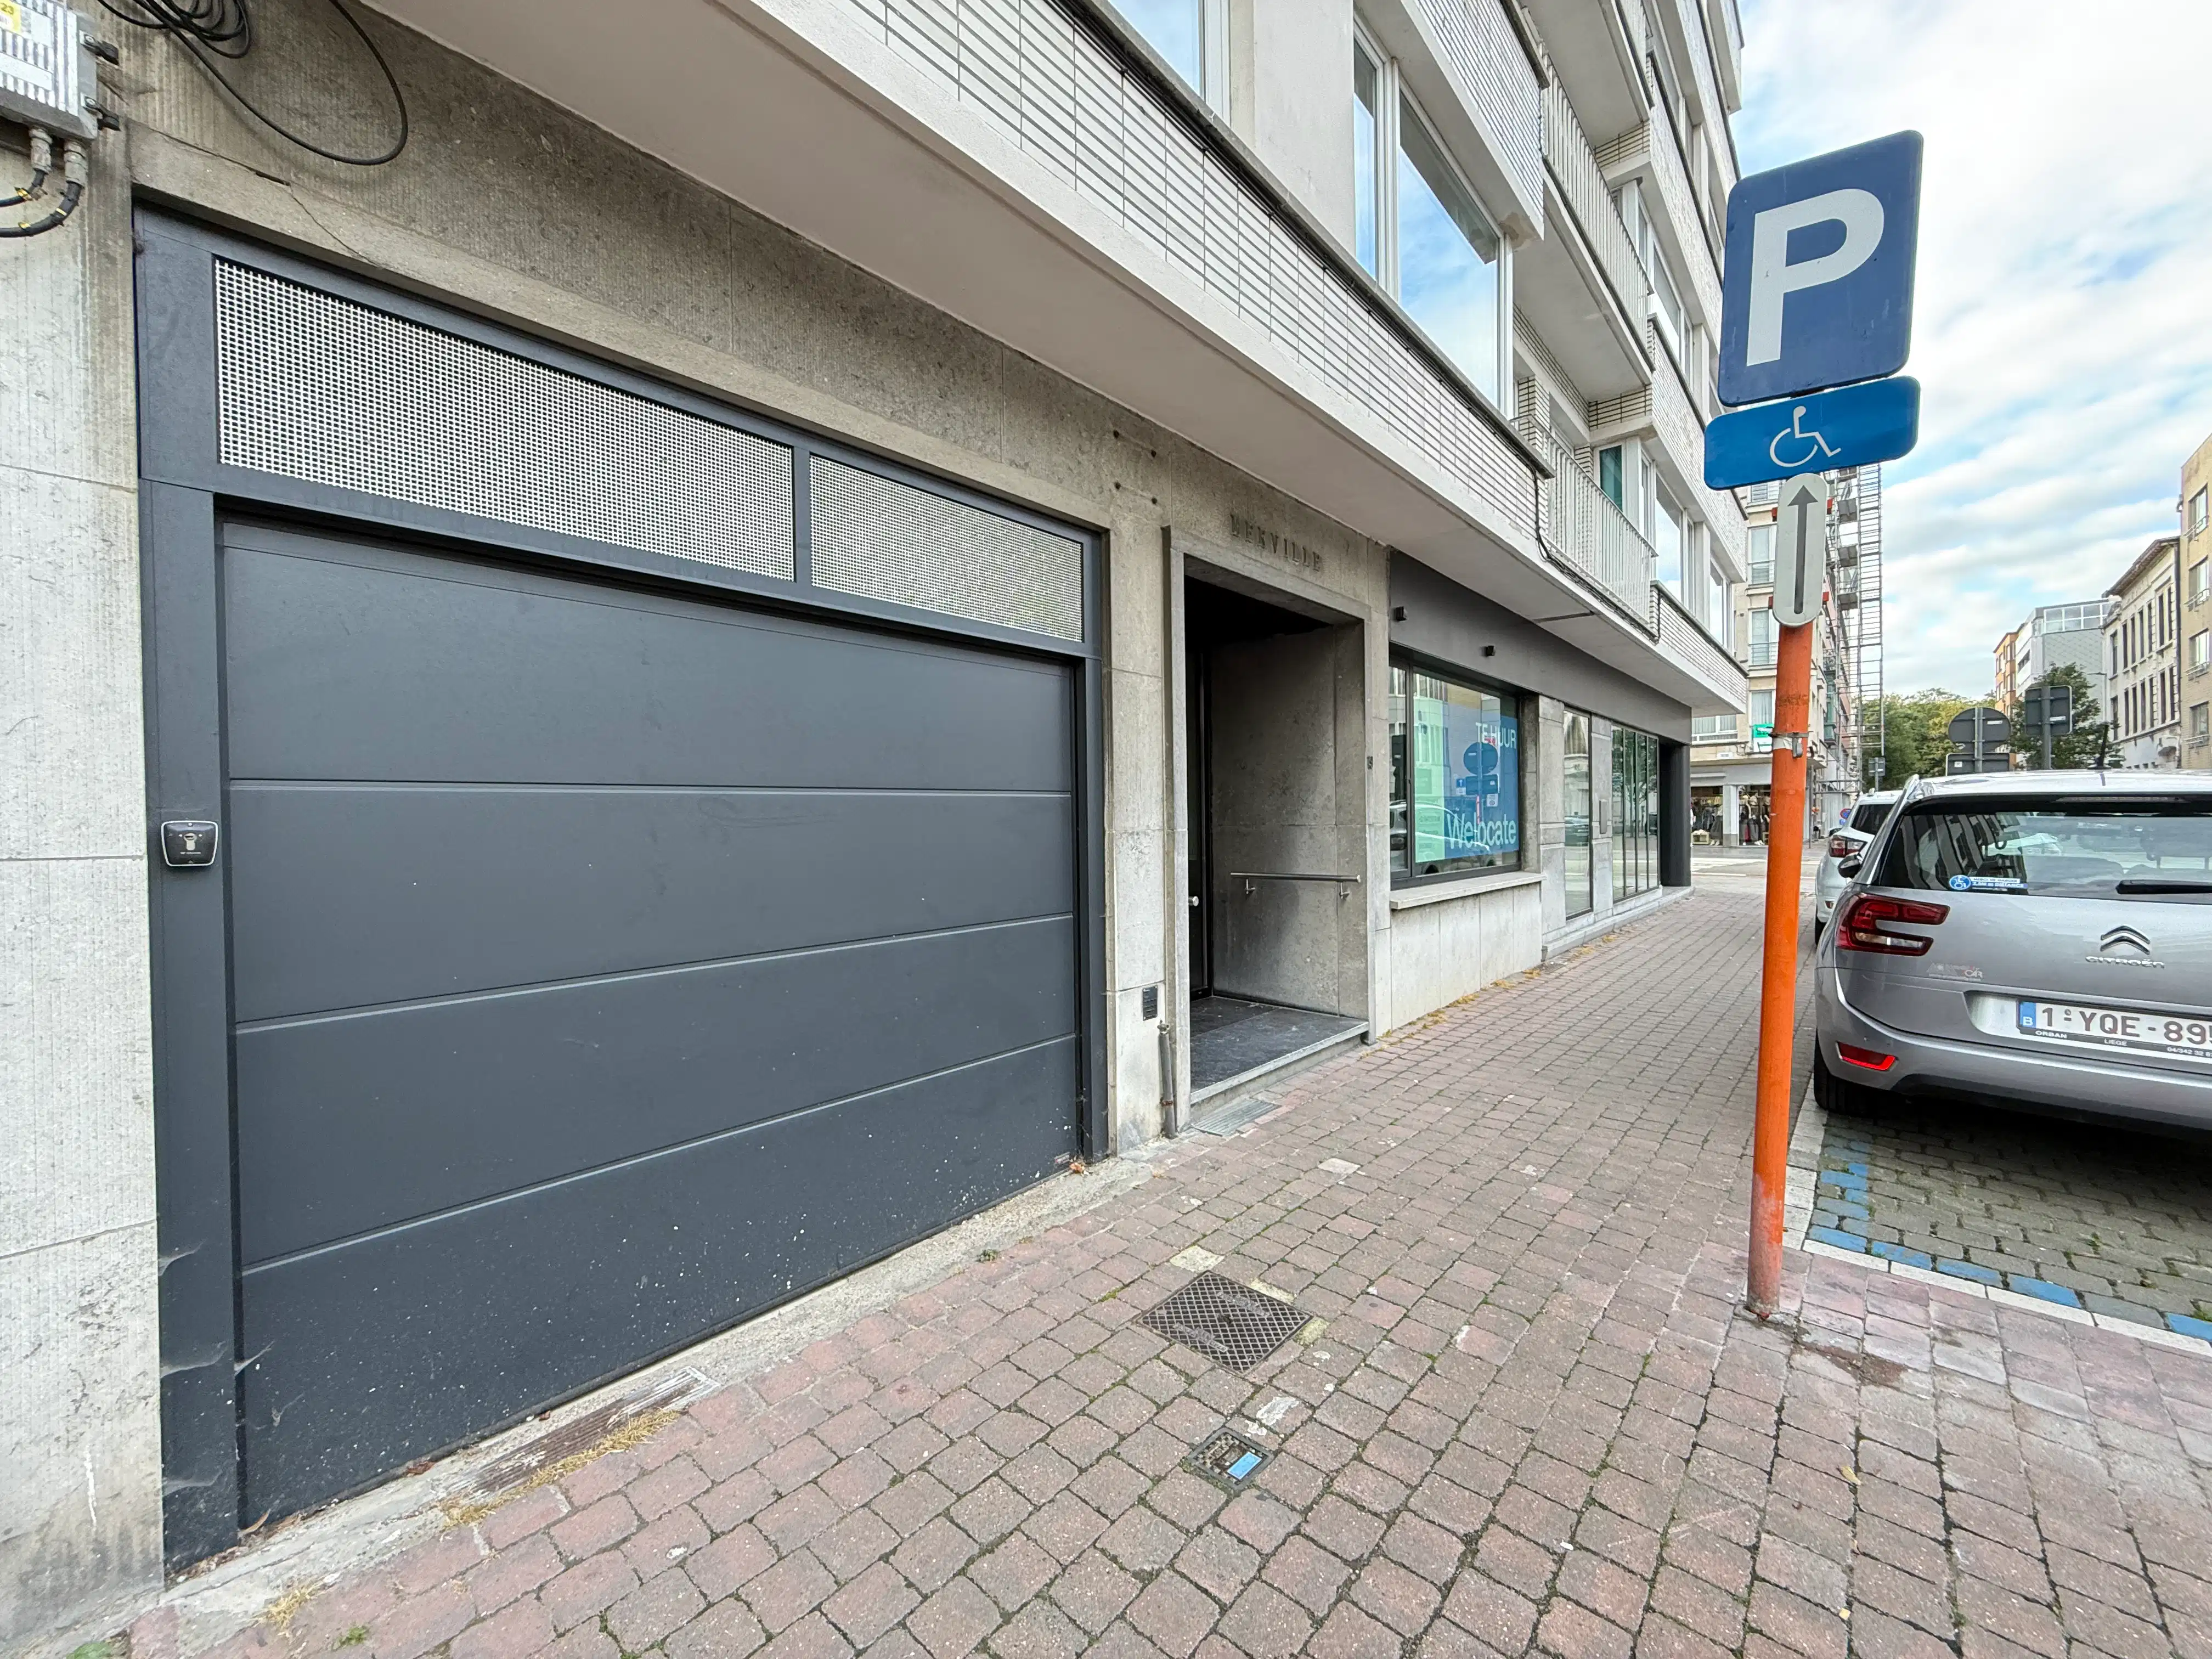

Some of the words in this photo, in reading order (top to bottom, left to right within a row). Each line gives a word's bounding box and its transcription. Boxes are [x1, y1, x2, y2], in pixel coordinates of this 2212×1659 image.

[1746, 188, 1885, 366] P
[1475, 722, 1488, 743] TE
[1490, 724, 1516, 749] HUUR
[1447, 812, 1517, 849] Welocate
[2023, 1016, 2033, 1025] B
[2035, 1030, 2067, 1039] ORBAN
[2042, 1007, 2212, 1045] 1-YQE-89
